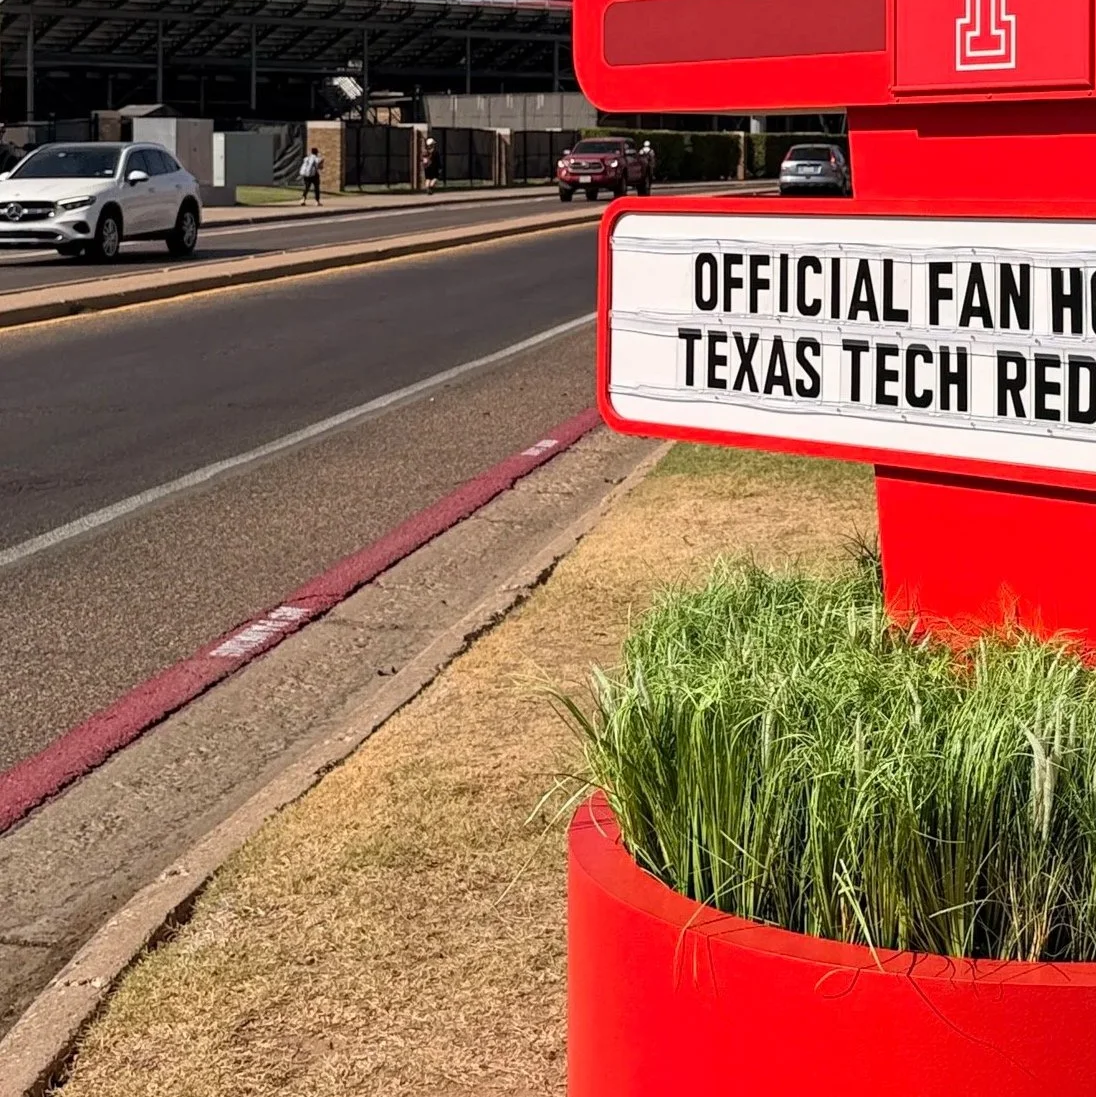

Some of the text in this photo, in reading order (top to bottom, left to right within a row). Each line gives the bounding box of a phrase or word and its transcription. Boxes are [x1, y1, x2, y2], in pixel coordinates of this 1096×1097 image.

[695, 252, 909, 323] OFFICIAL
[928, 261, 1031, 331] FAN
[677, 327, 821, 399] TEXAS
[841, 338, 968, 412] TECH
